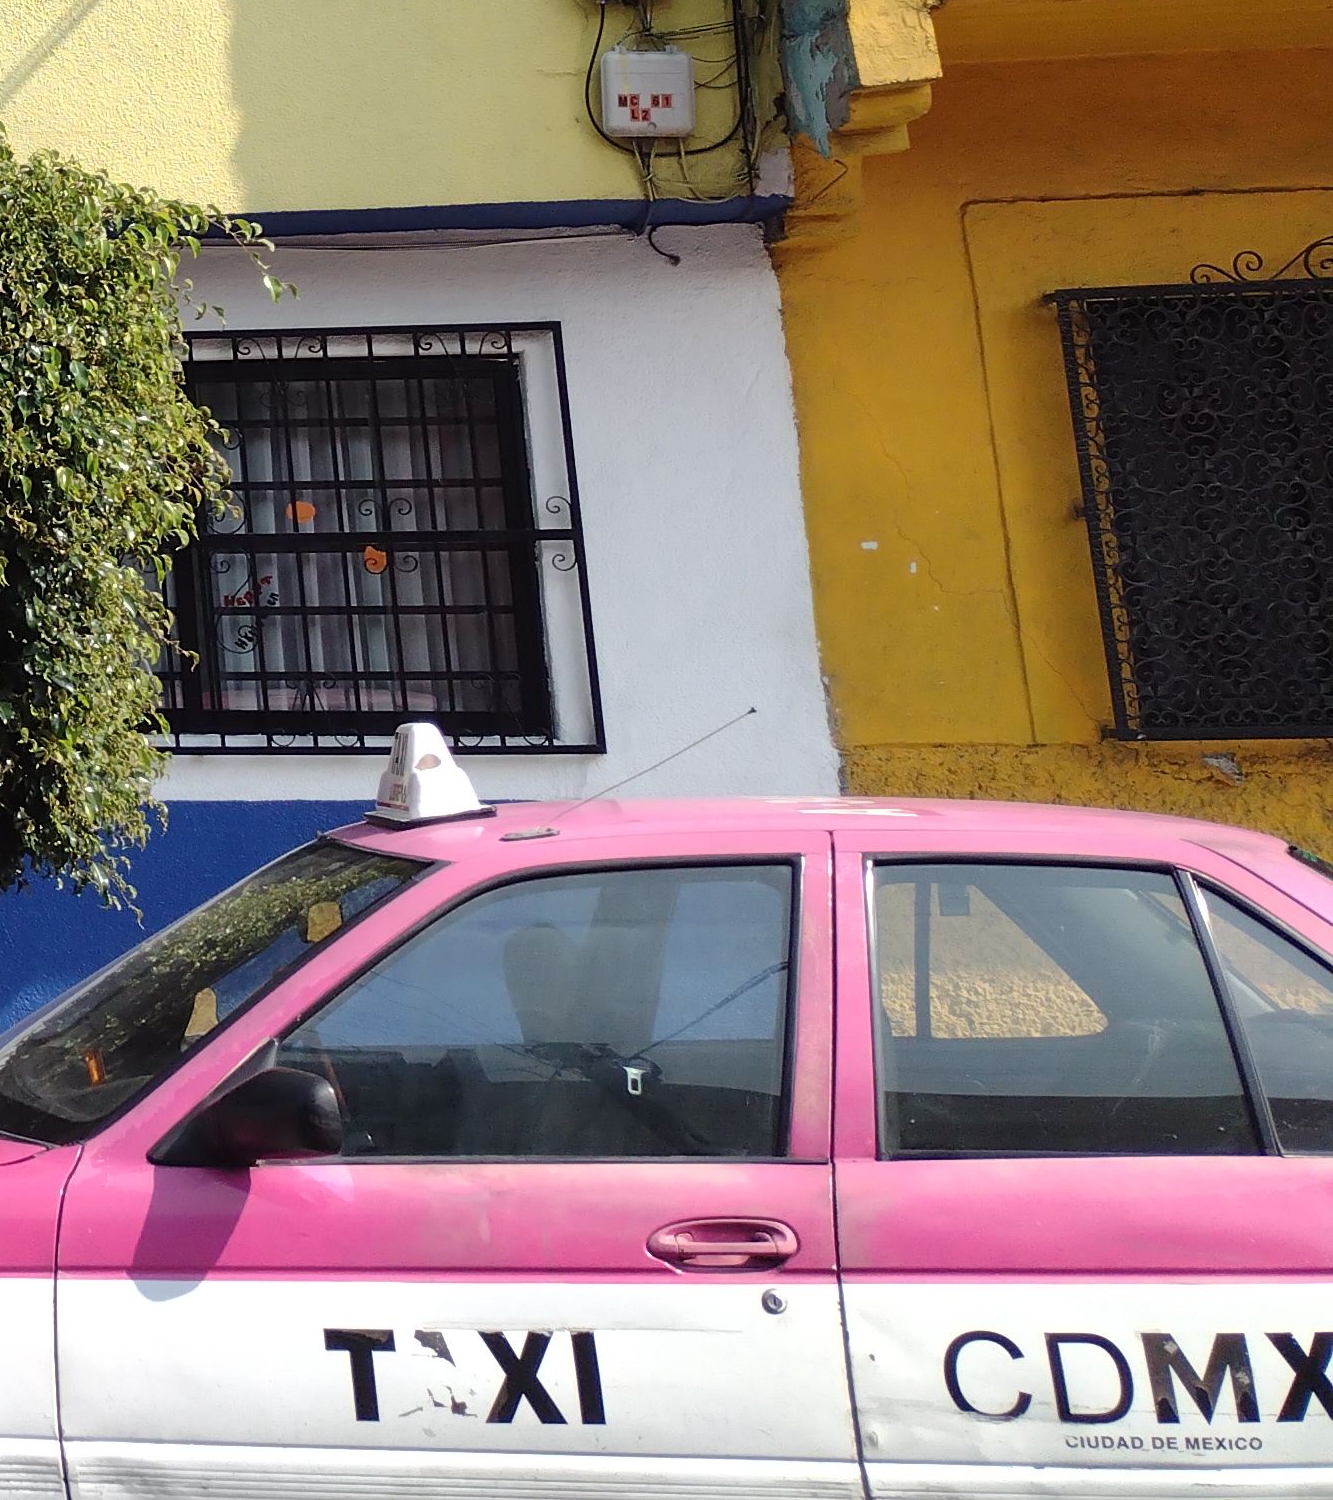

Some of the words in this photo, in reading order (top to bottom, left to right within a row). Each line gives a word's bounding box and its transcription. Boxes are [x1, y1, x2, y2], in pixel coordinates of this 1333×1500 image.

[631, 109, 649, 120] L2
[943, 1330, 1333, 1426] CDMX
[1065, 1435, 1144, 1450] CIUDAD
[1151, 1436, 1179, 1450] DE
[1185, 1437, 1263, 1451] MEXICO
